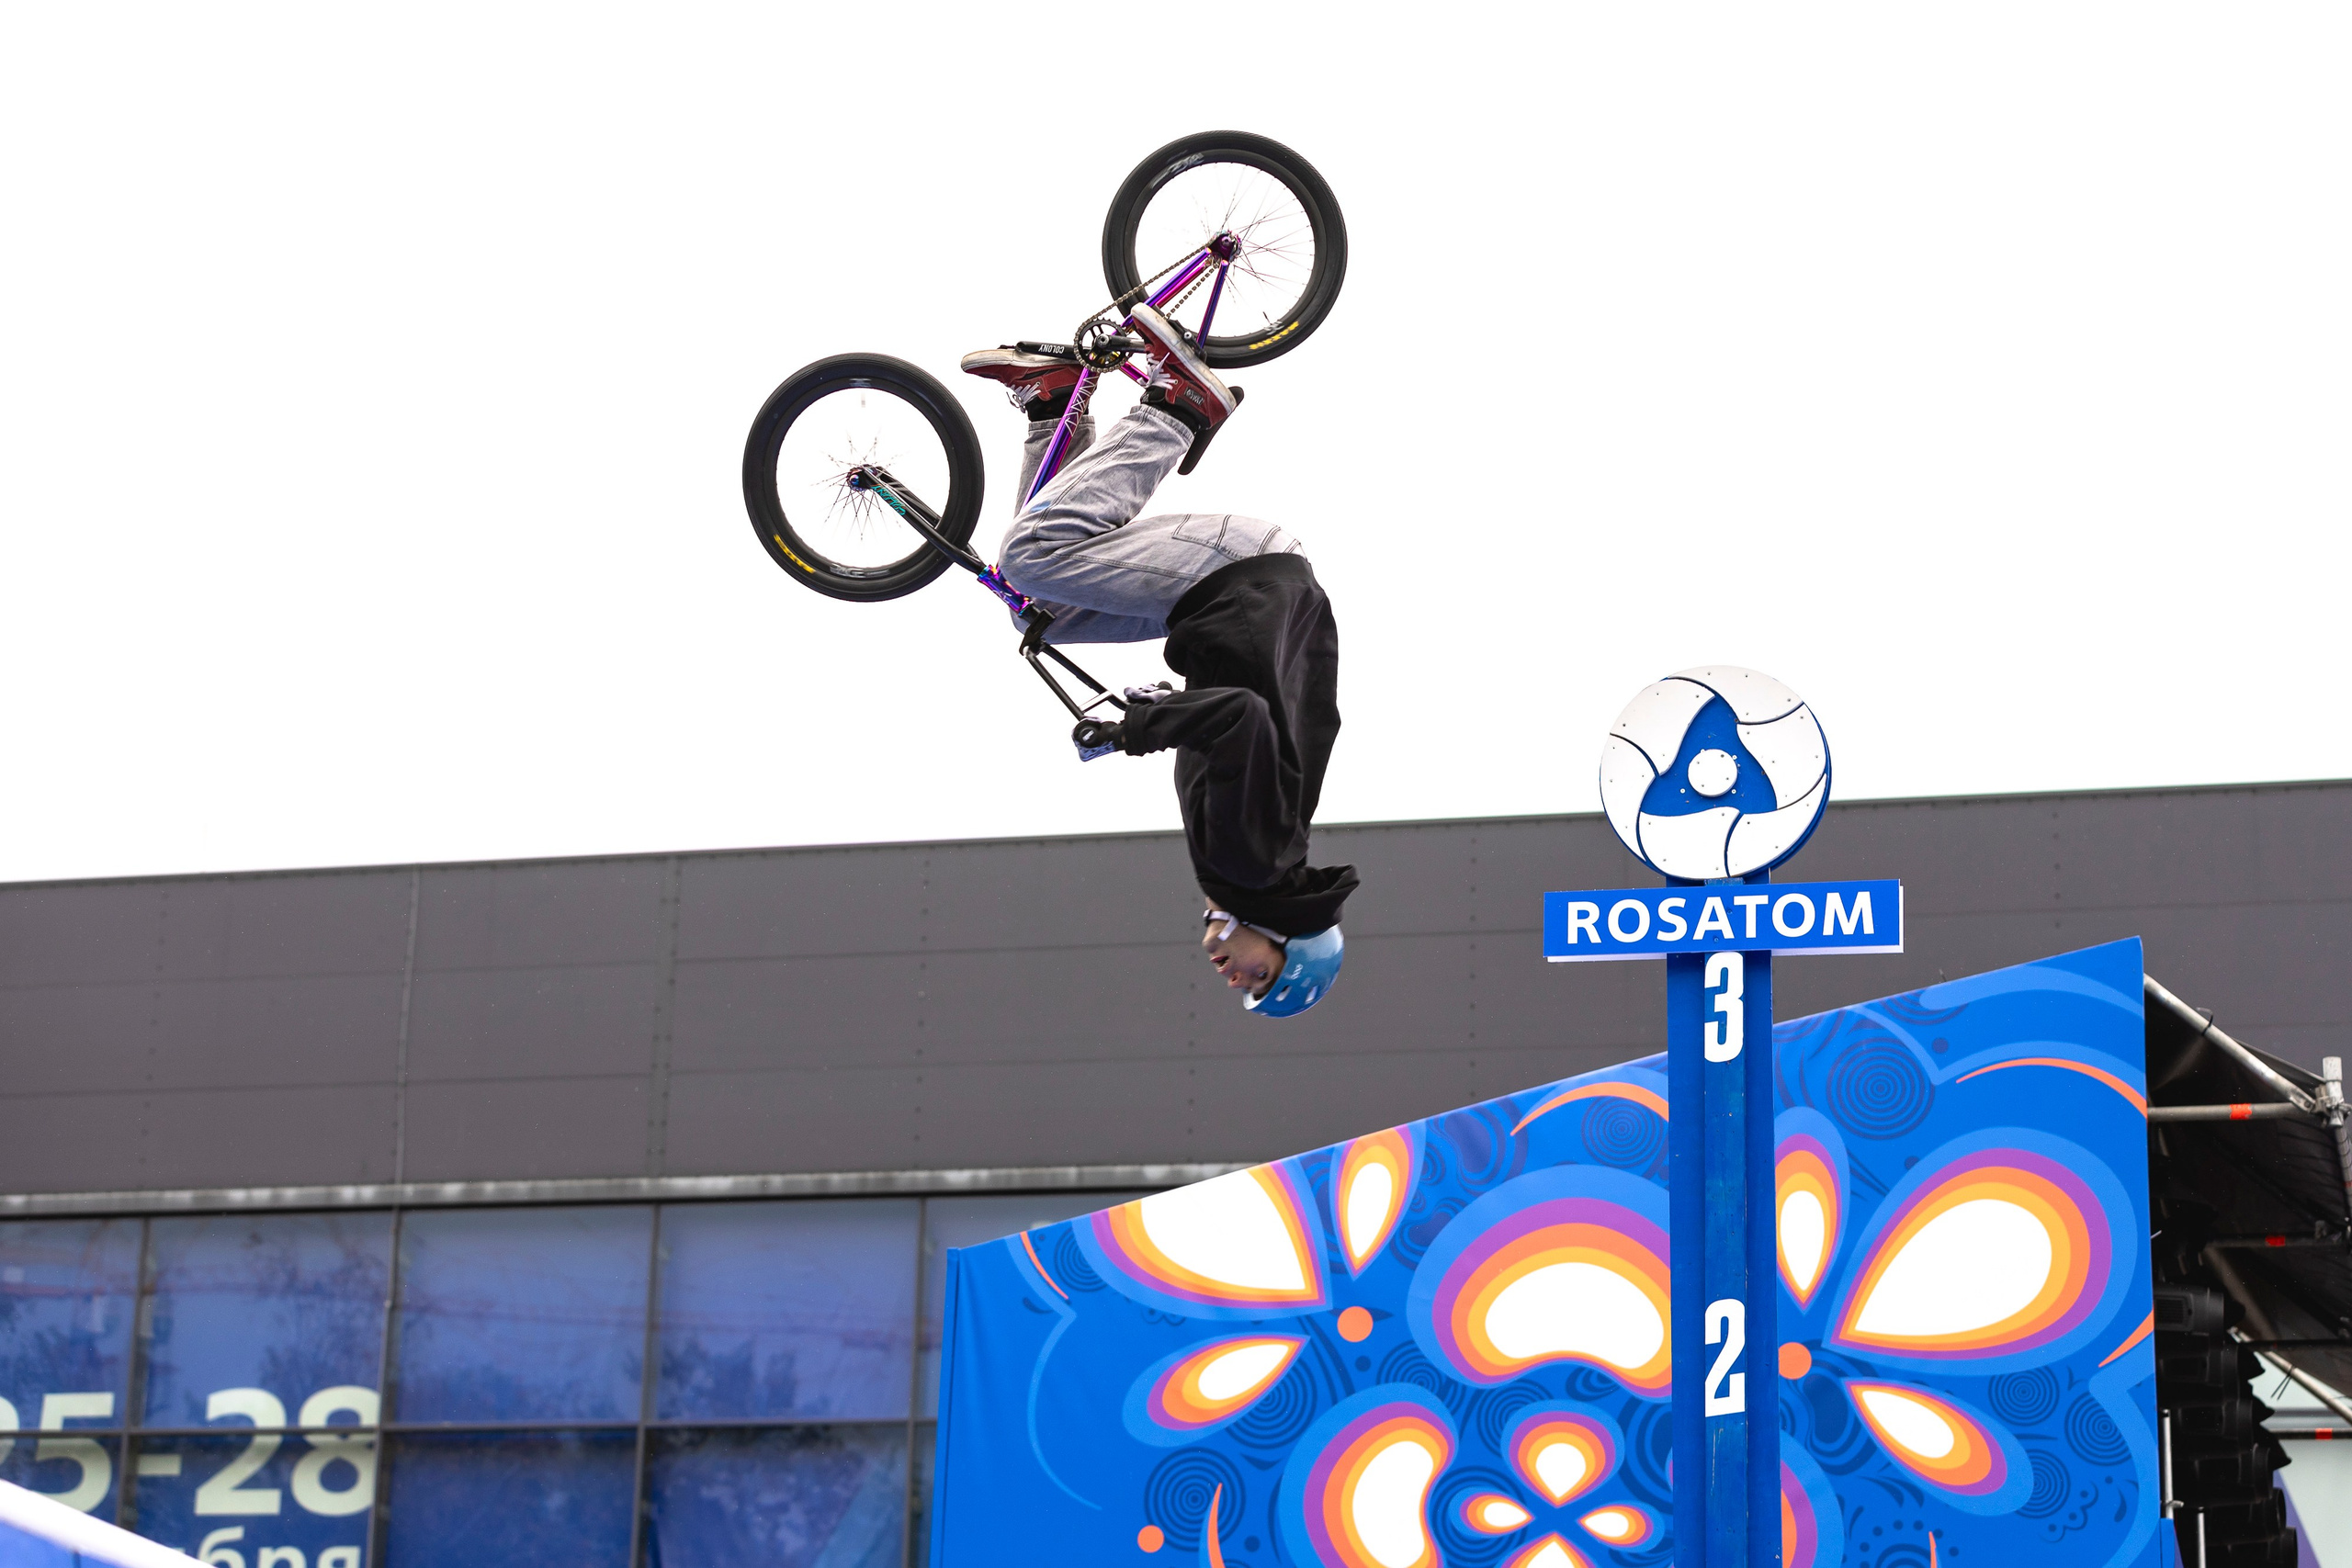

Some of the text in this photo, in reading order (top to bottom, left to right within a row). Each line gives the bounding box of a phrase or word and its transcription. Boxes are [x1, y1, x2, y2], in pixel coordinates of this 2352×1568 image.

[1038, 344, 1065, 355] COLONY
[1566, 890, 1875, 945] ROSATOM
[1704, 951, 1745, 1064] 3
[1704, 1298, 1746, 1417] 2
[0, 1385, 380, 1517] 5-28
